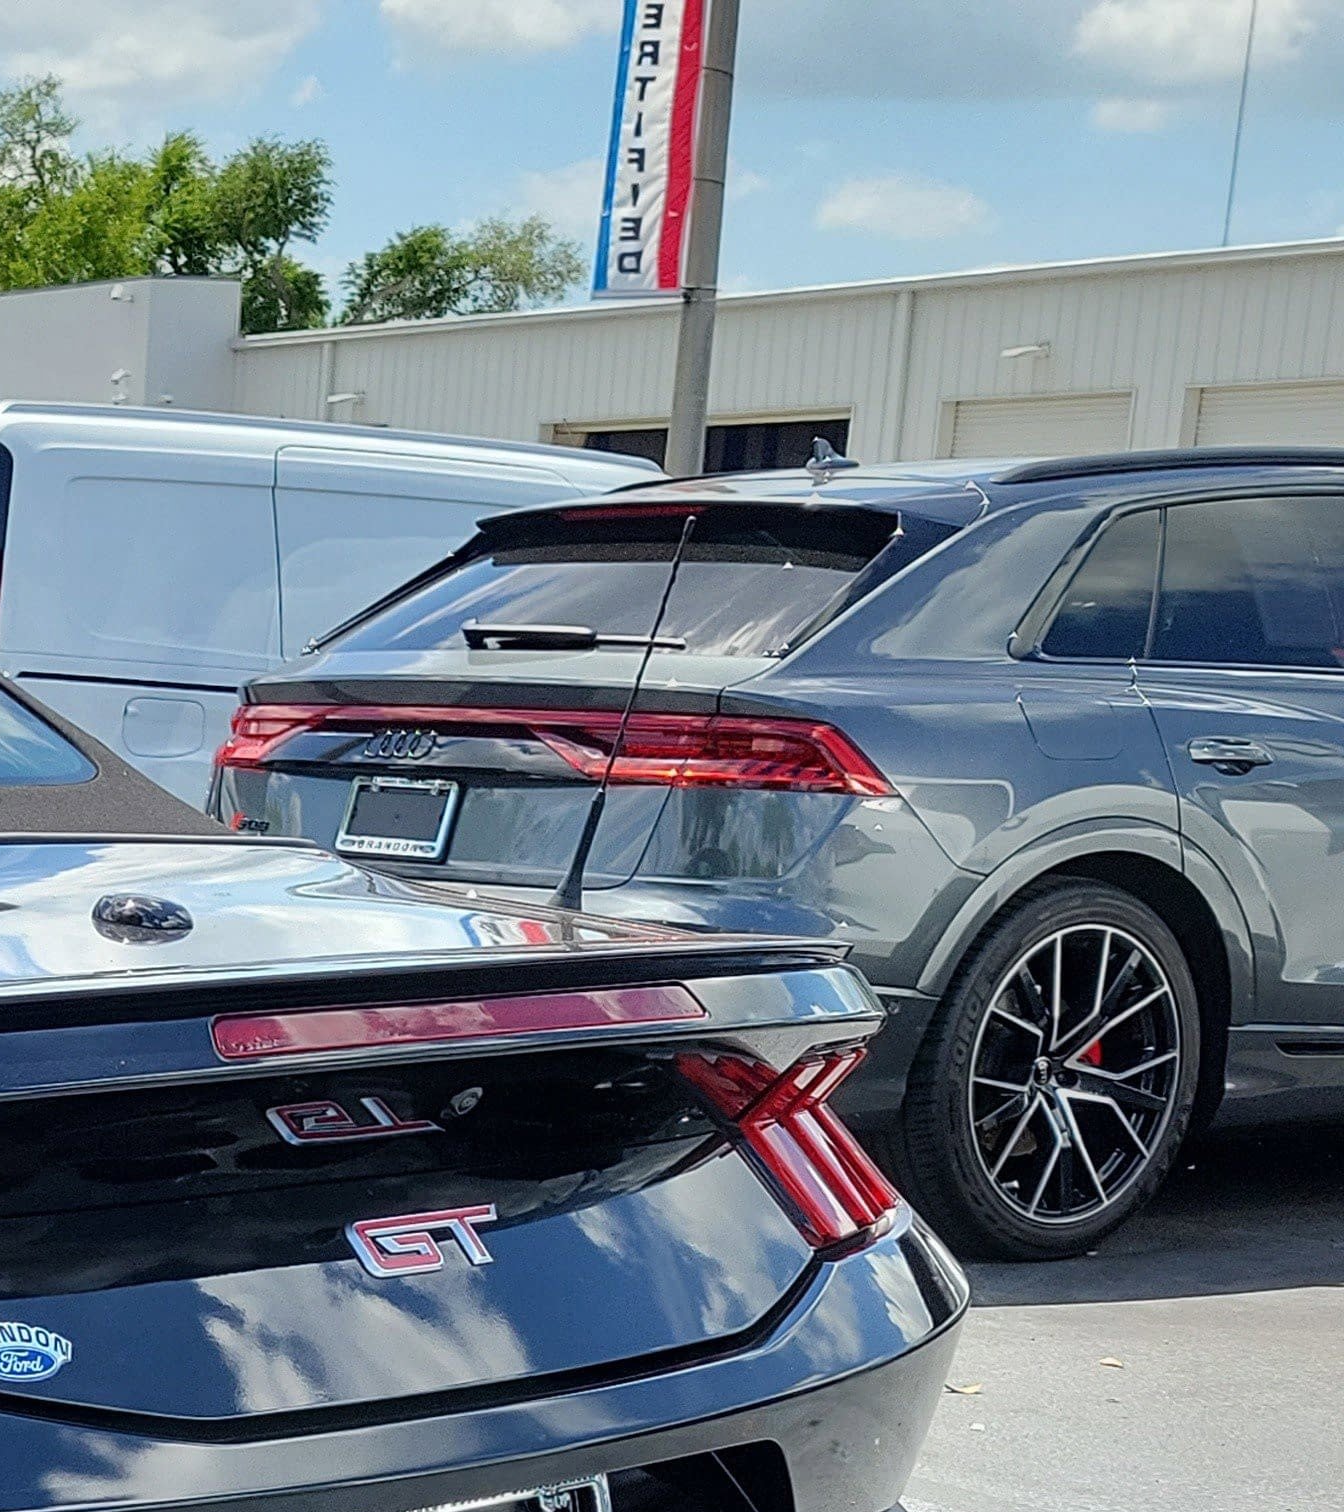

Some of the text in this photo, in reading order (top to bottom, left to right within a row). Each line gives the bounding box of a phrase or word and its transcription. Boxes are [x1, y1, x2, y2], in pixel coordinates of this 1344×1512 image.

[355, 838, 419, 853] BRANDON
[345, 1202, 498, 1280] GT
[0, 1350, 44, 1374] Ford
